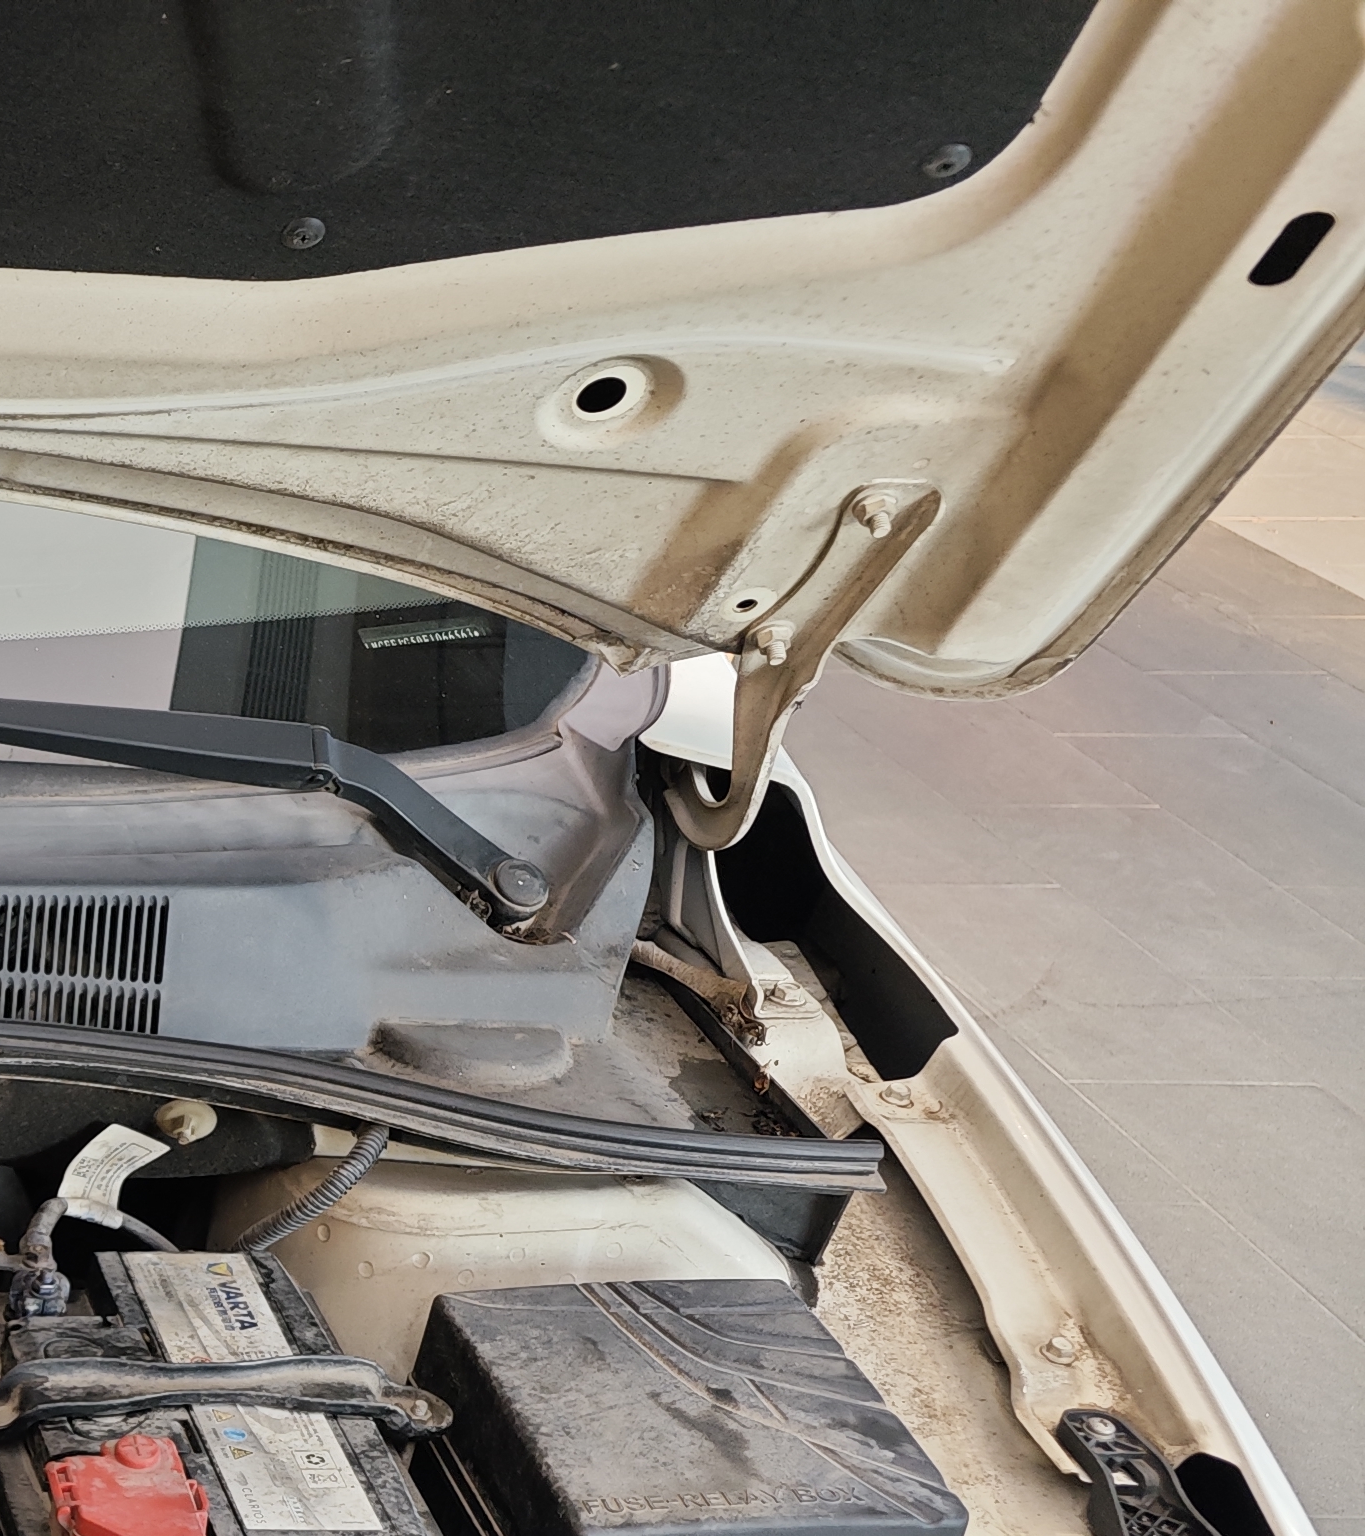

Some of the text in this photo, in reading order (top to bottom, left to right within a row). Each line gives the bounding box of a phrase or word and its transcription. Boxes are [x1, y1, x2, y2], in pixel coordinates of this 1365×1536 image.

[218, 1280, 258, 1331] VARTA
[241, 1487, 267, 1524] CLARIOS
[581, 1485, 867, 1515] FUSE-RELAY BOX
